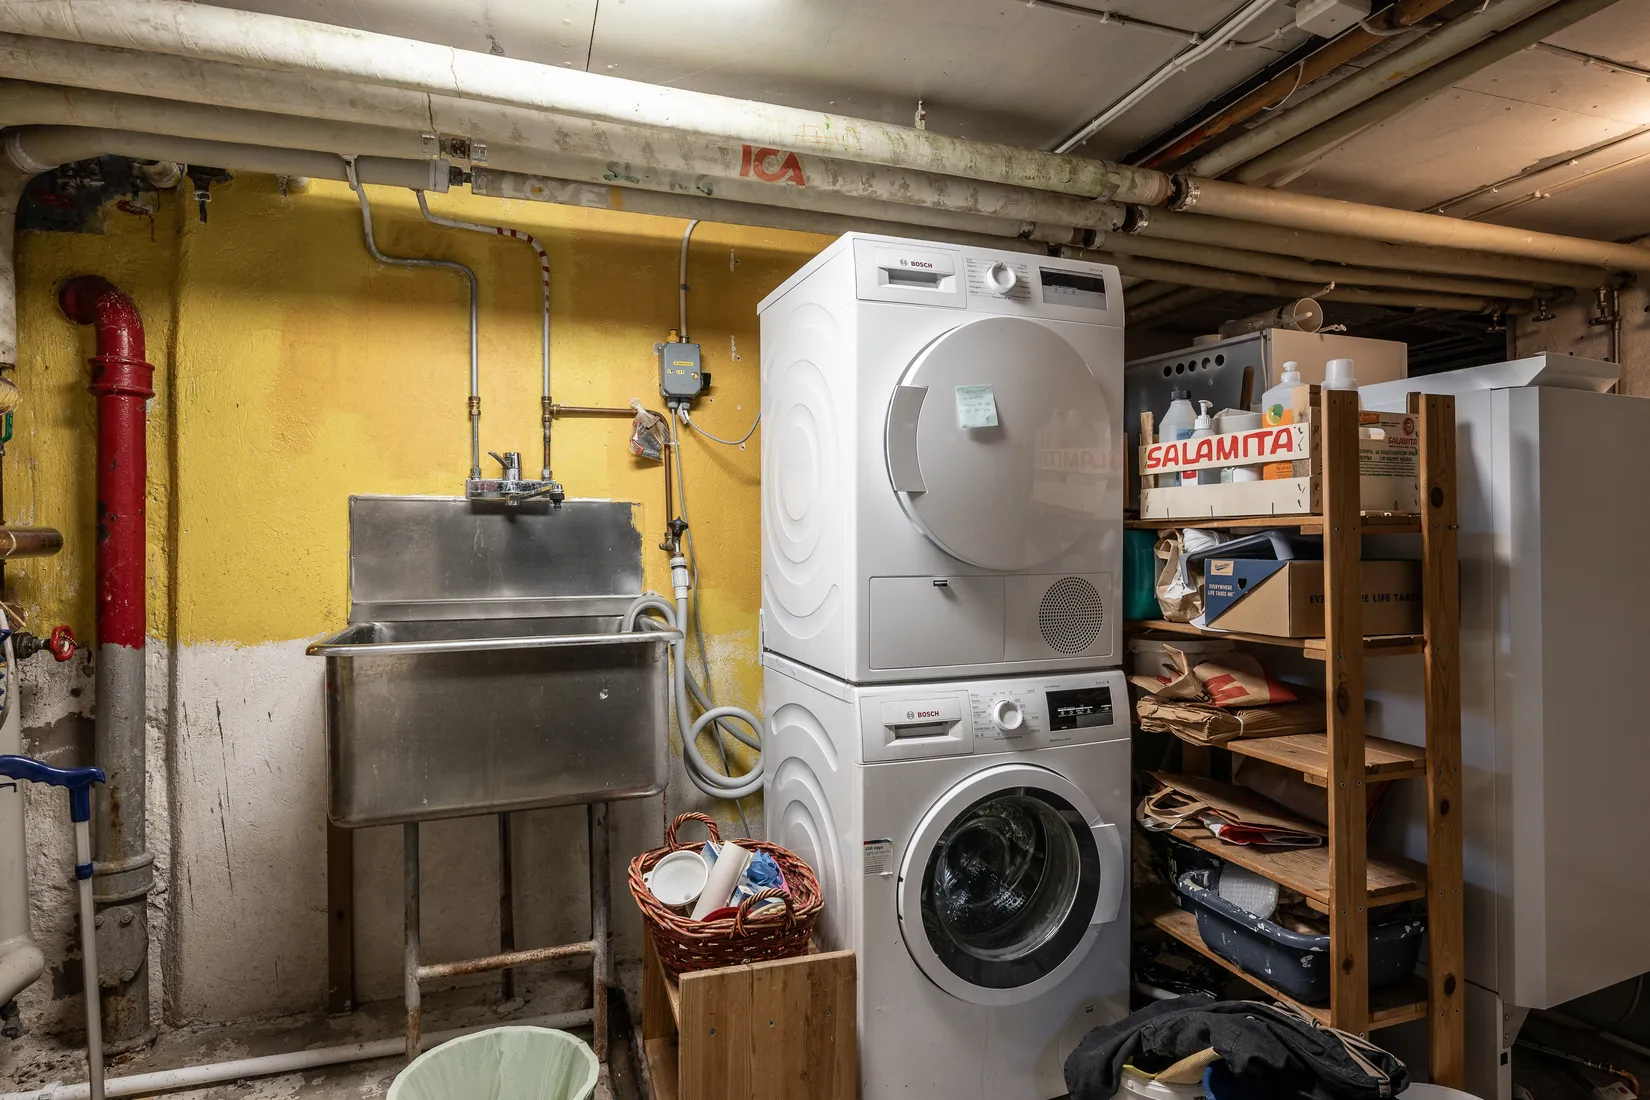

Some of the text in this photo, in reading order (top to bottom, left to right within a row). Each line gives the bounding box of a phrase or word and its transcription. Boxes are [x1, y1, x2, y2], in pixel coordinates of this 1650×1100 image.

[739, 144, 807, 187] ICA
[910, 261, 933, 269] BOSCH
[1146, 427, 1294, 469] SALAMITA
[1208, 583, 1233, 591] EVERYWHERE
[1372, 593, 1390, 602] LIFE
